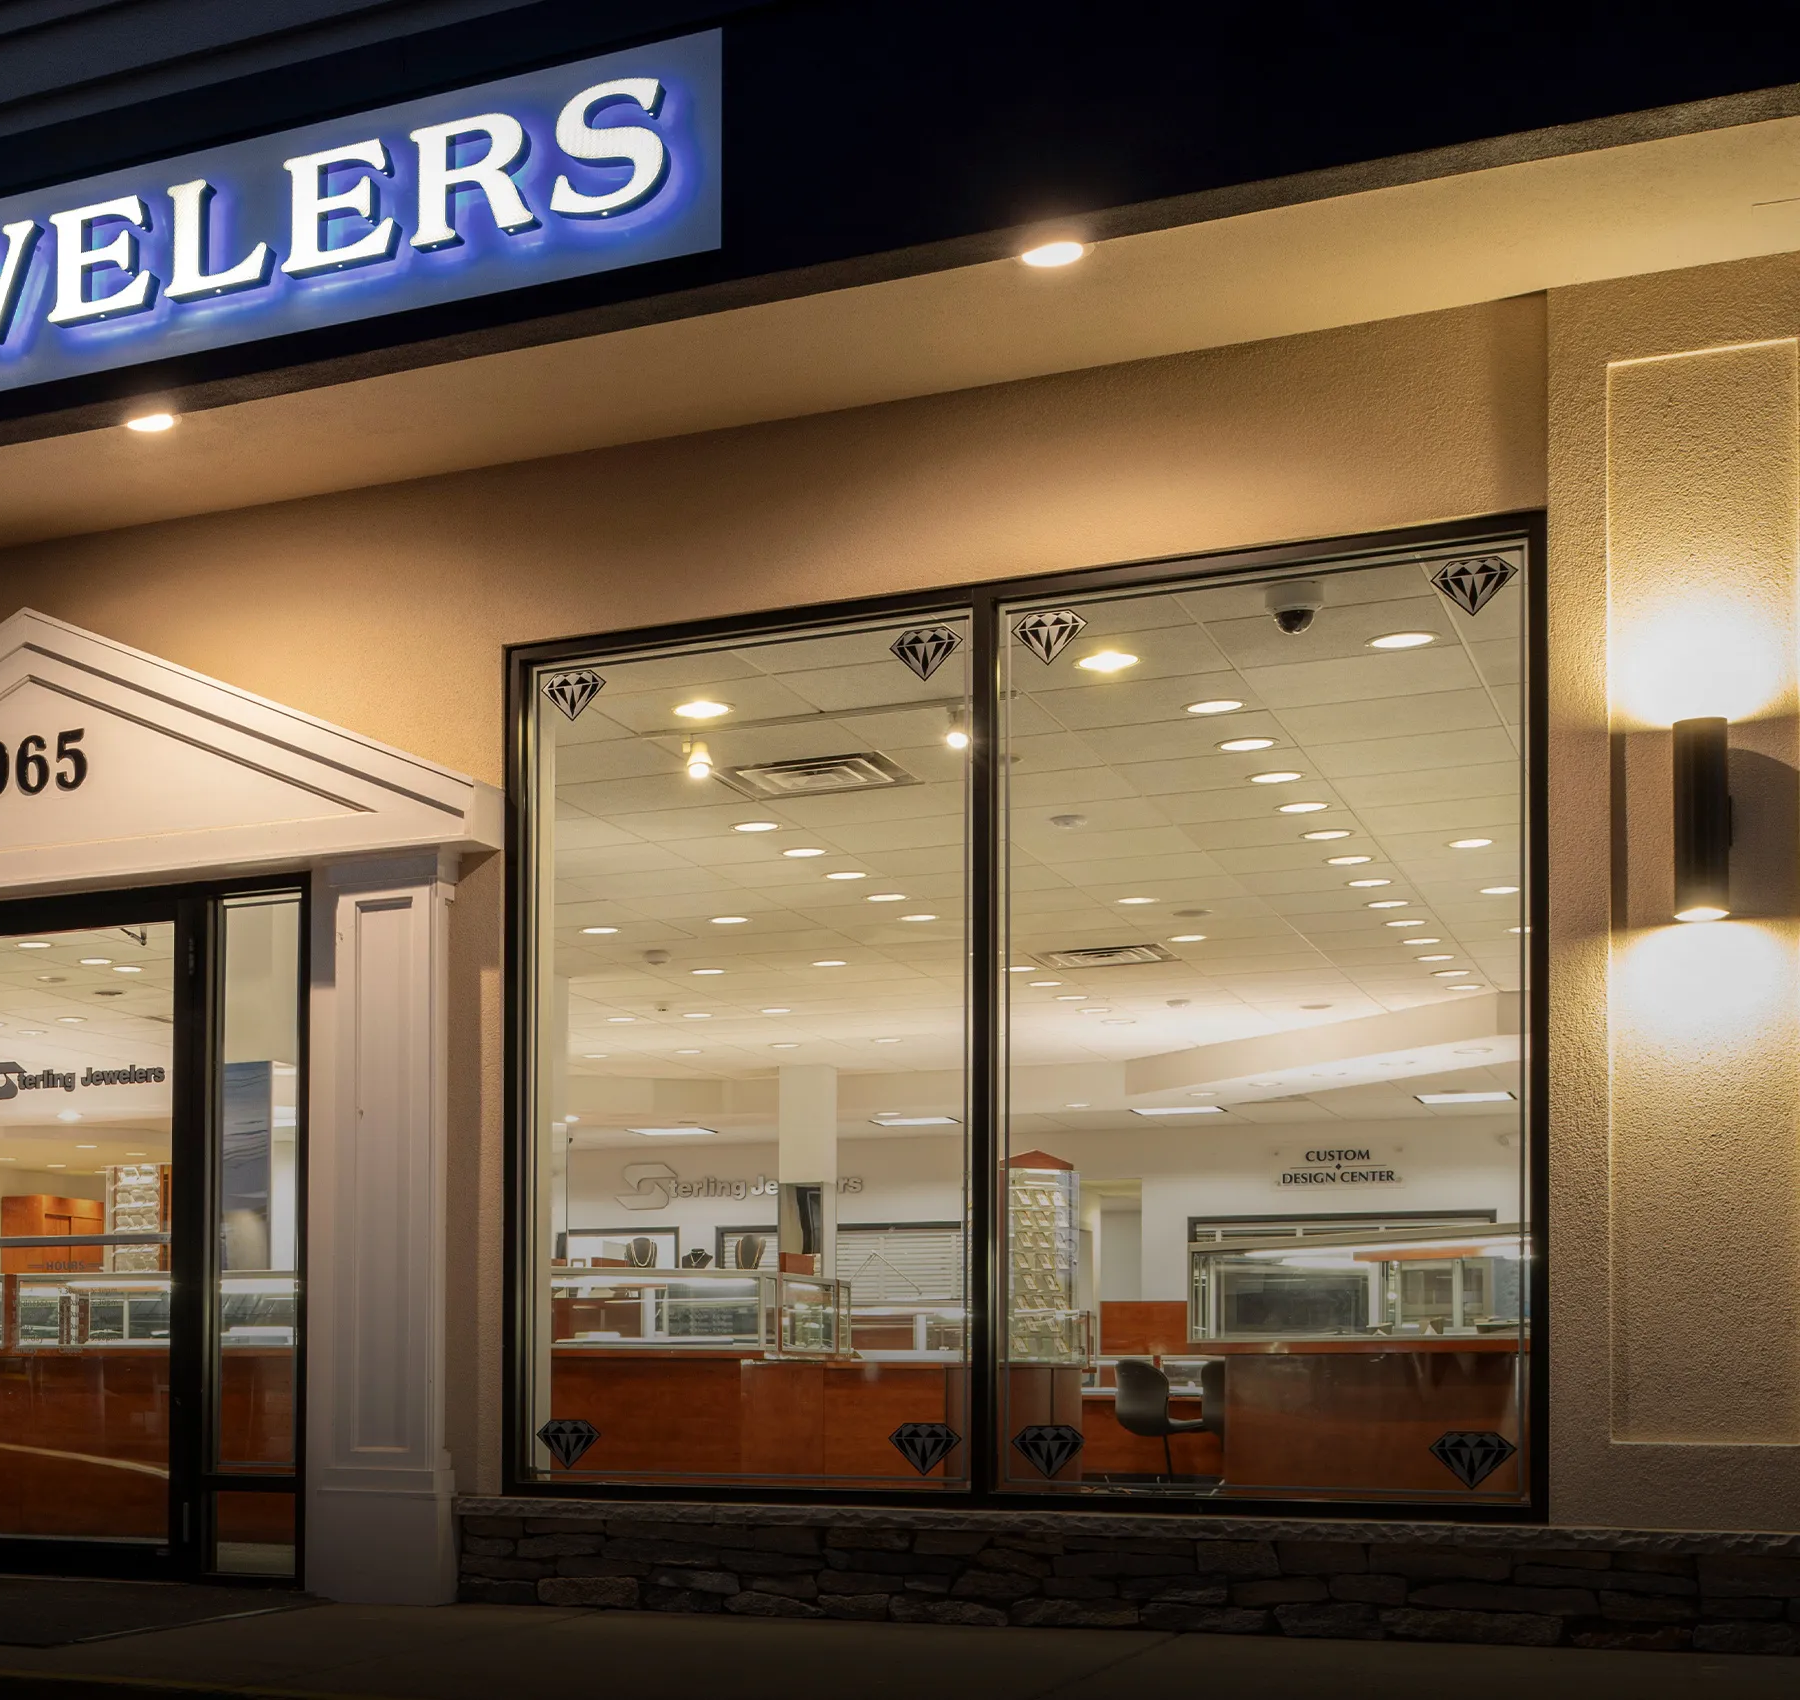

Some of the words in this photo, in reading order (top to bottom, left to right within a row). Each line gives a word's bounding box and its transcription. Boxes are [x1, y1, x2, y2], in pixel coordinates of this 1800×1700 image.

[81, 1064, 165, 1087] Jewelers
[1305, 1149, 1371, 1162] CUSTOM
[1281, 1172, 1336, 1184] DESIGN
[1340, 1170, 1395, 1182] CENTER
[615, 1162, 747, 1210] Sterling
[750, 1174, 863, 1196] Jers
[46, 1261, 85, 1271] HOURS
